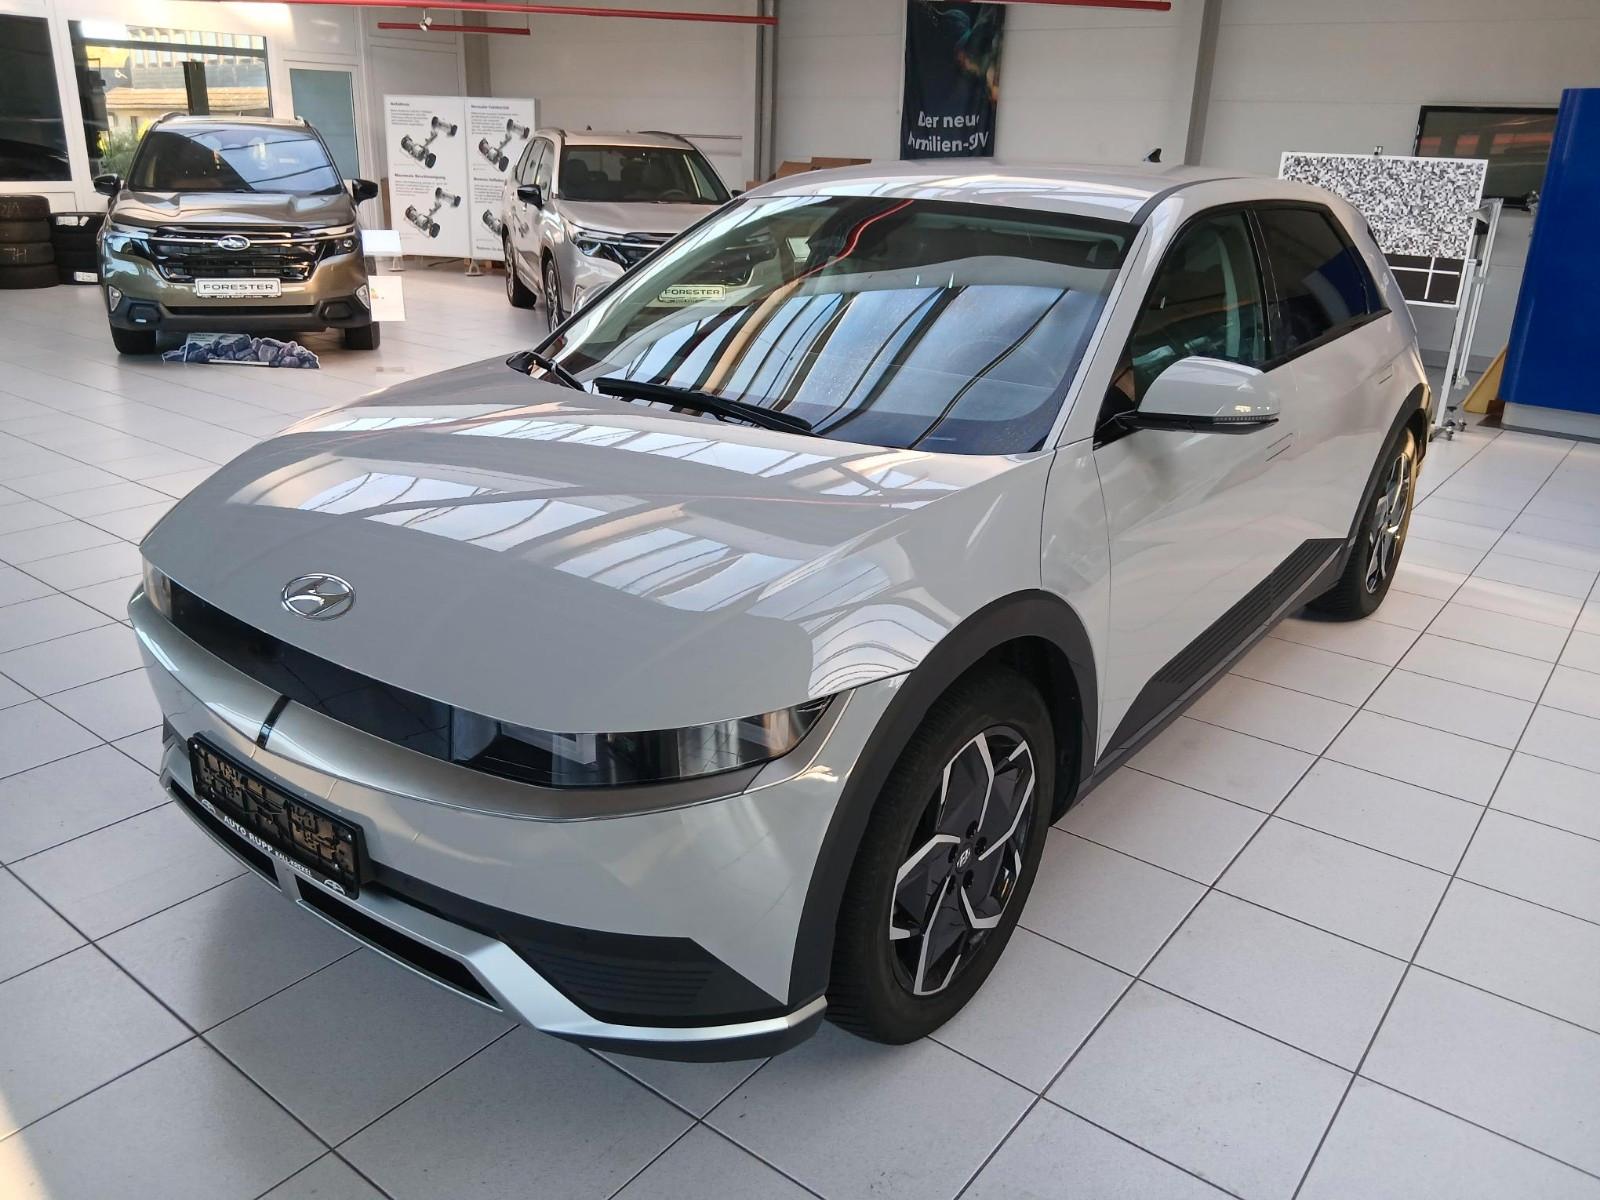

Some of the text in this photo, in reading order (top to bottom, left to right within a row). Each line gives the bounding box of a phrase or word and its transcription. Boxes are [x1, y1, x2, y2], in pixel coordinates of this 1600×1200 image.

[917, 111, 939, 128] Der
[224, 815, 247, 836] AUTO
[249, 832, 273, 851] RUPP
